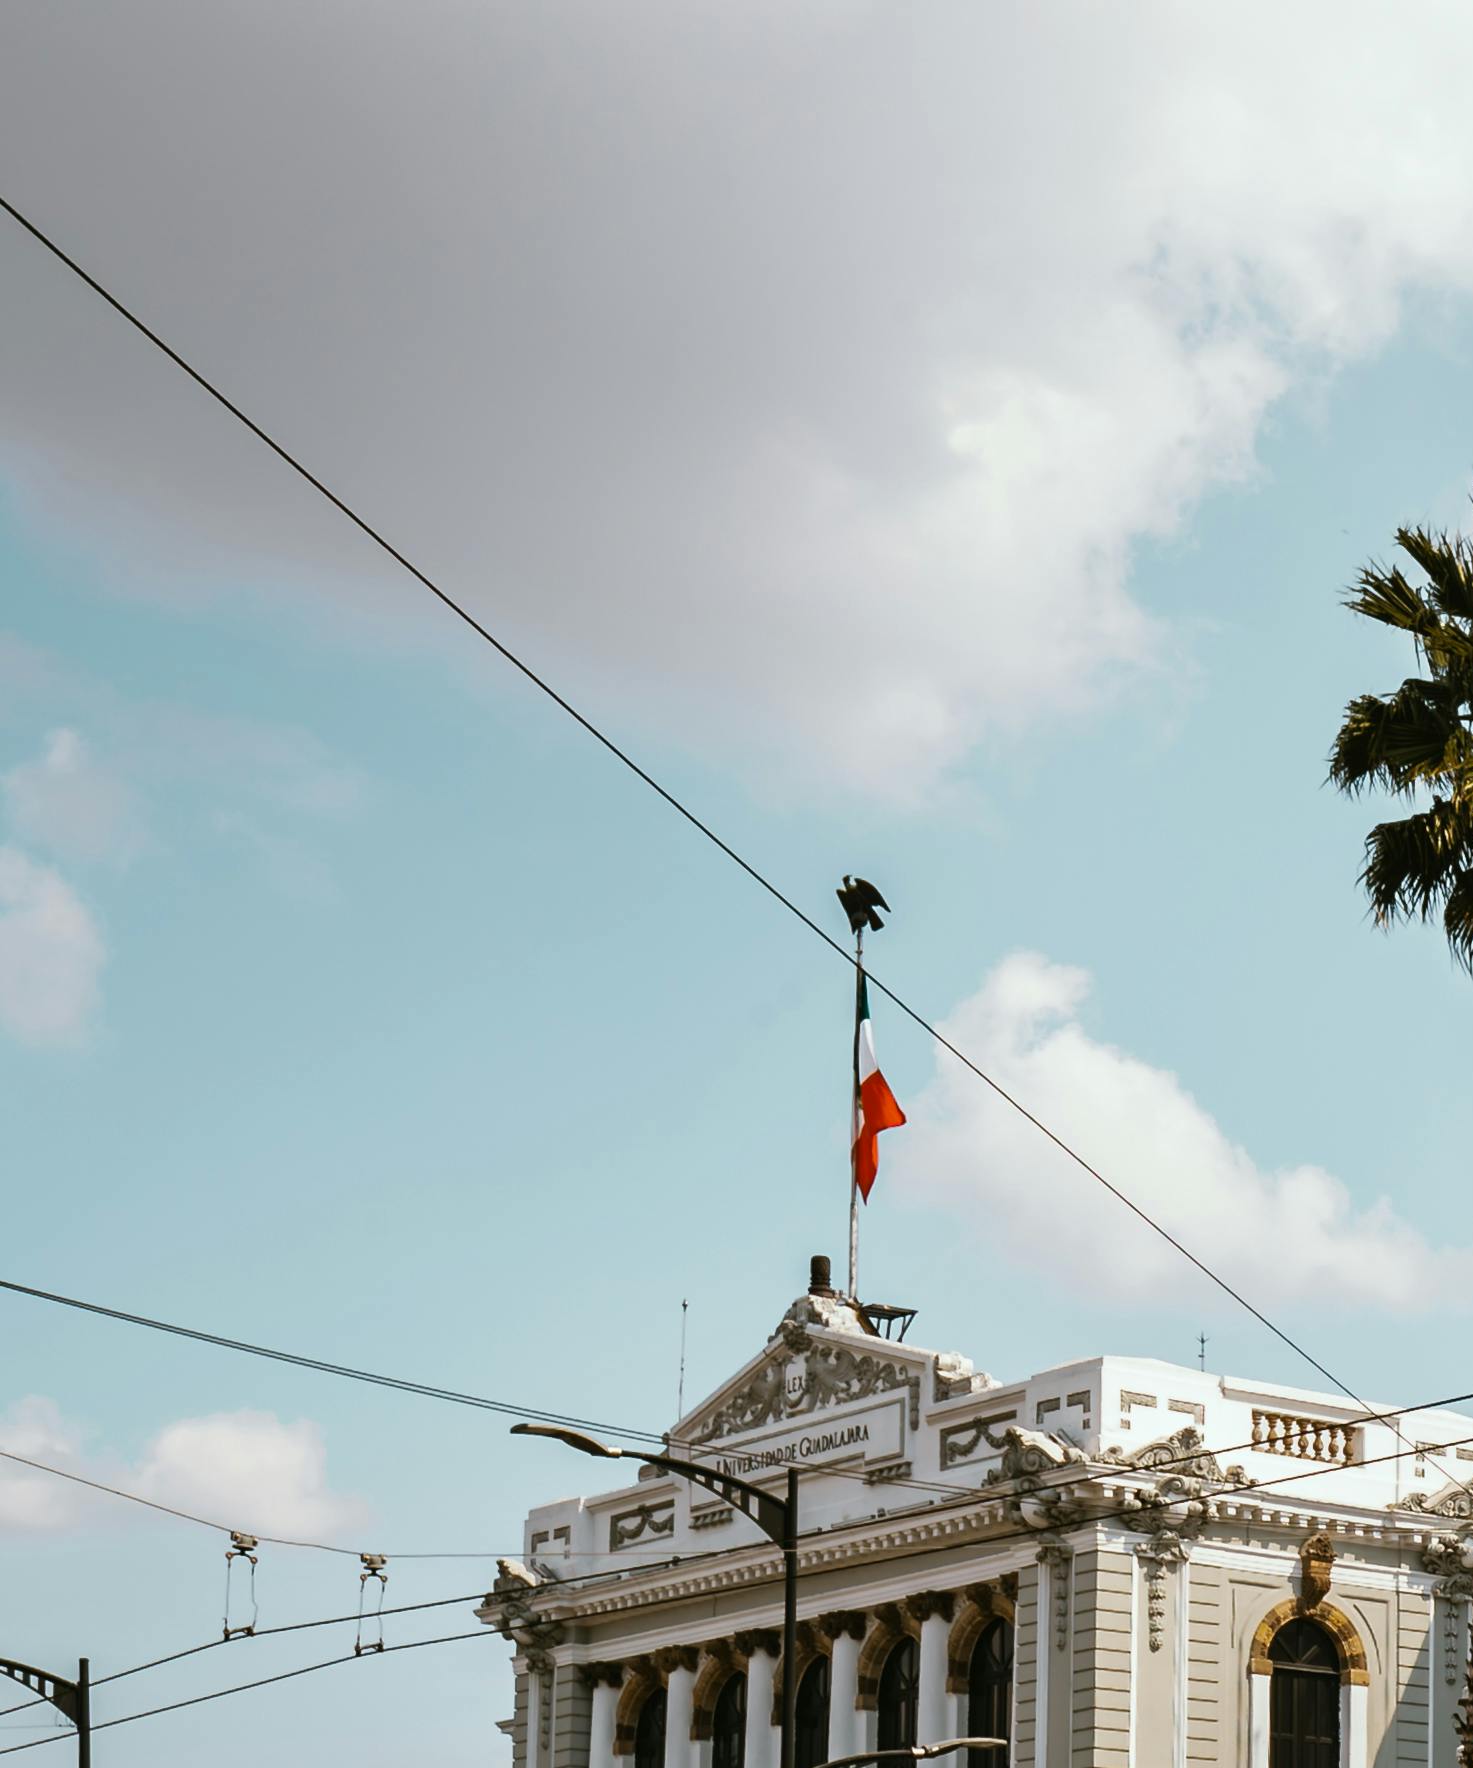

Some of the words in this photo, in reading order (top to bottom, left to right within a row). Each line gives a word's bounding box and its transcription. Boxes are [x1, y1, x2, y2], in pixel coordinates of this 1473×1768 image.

[786, 1375, 804, 1394] LEX
[784, 1444, 797, 1462] DE
[799, 1424, 870, 1457] GUADALAJARA
